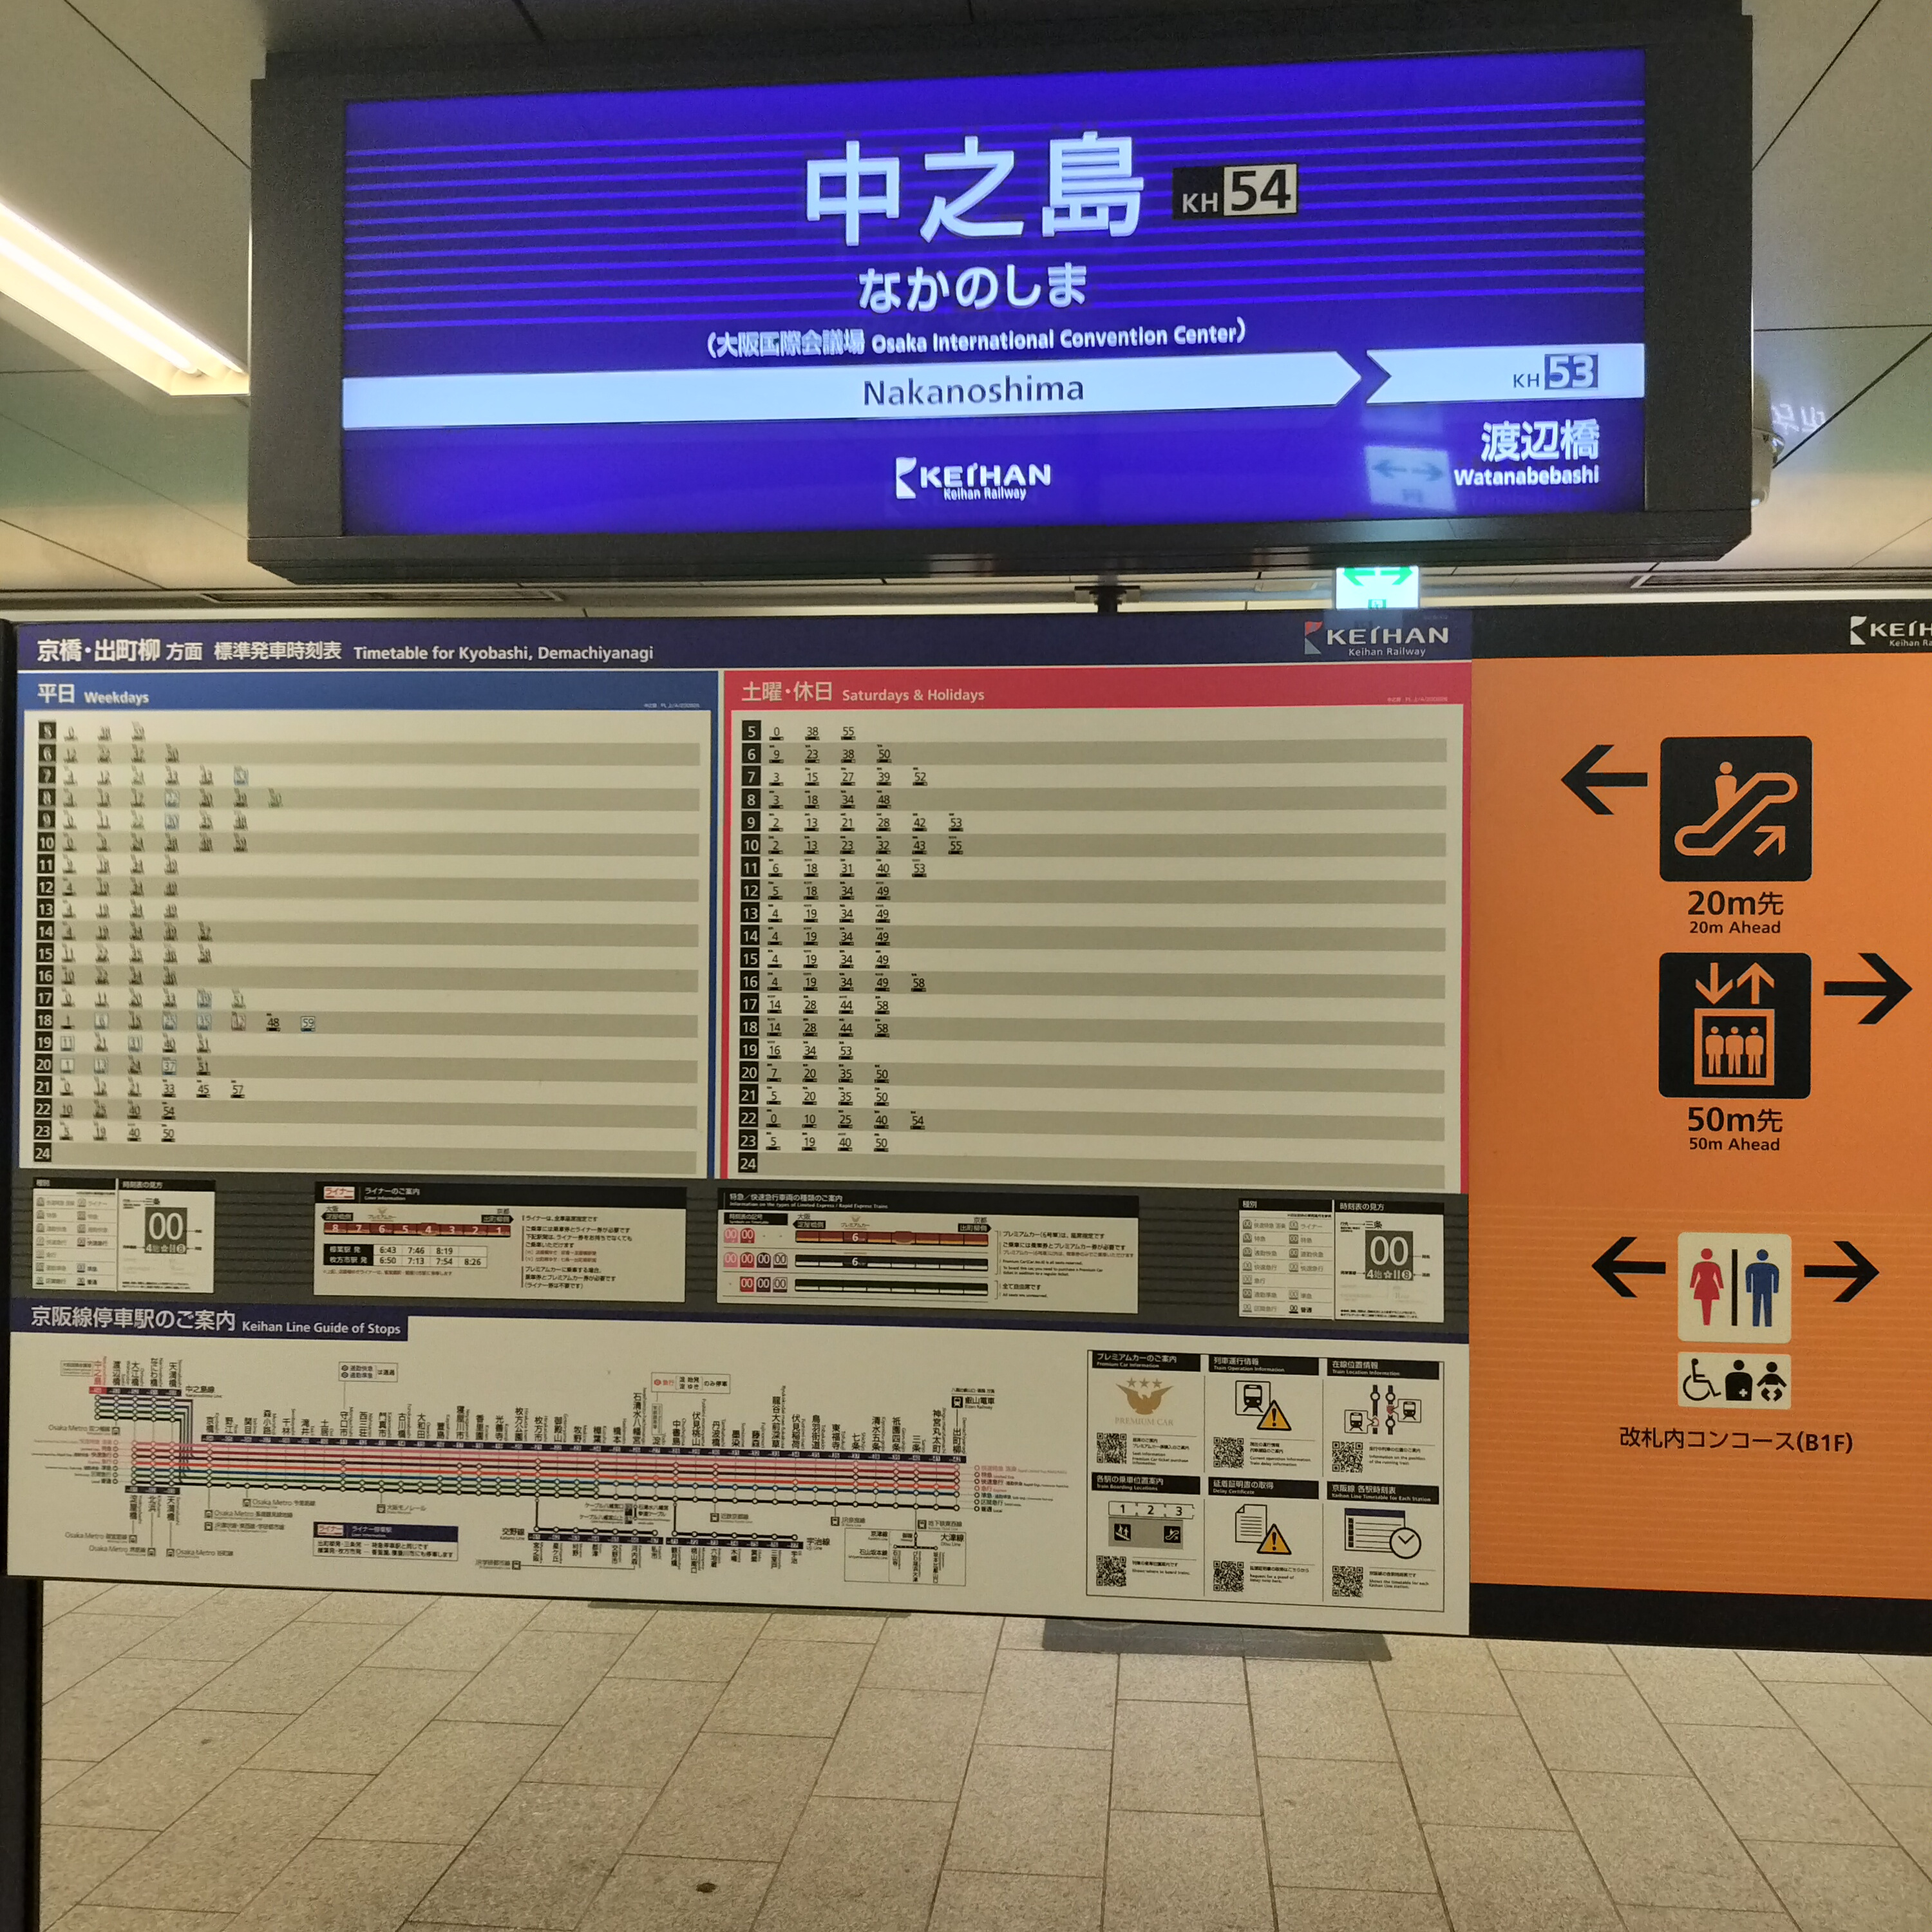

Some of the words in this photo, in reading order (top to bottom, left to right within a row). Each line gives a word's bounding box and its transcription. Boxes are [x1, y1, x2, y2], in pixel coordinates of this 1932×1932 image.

[806, 131, 1144, 247] 中之島
[1182, 193, 1218, 214] KH
[1230, 170, 1291, 212] 54
[858, 261, 1088, 314] なかのしま
[872, 334, 927, 354] Osaka
[933, 328, 1054, 352] International
[1060, 325, 1167, 348] Convention
[1174, 317, 1245, 345] Center)
[1513, 374, 1540, 388] KH
[1547, 355, 1596, 388] 53
[863, 375, 1085, 408] Nakanoshima
[1481, 419, 1600, 463] 渡辺橋
[920, 462, 1051, 488] KEIHAN
[1454, 466, 1600, 487] Watanabebashi
[943, 488, 980, 500] Keihan
[984, 486, 1027, 501] Railway
[1327, 626, 1448, 645] KEIHAN
[37, 638, 160, 663] 京橋・出町柳
[166, 642, 203, 661] 方面
[214, 641, 342, 661] 標準発車時刻表
[354, 646, 428, 660] Timetable
[432, 646, 454, 660] for
[459, 646, 533, 662] Kyobashi,
[538, 646, 654, 663] Demachiyanagi
[1349, 648, 1383, 656] Keihan
[1387, 647, 1426, 657] Railway
[37, 683, 75, 704] 平日
[84, 692, 149, 704] Weekdays
[742, 681, 833, 703] 土曜・休日
[842, 690, 909, 703] Saturdays
[913, 690, 923, 701] &
[928, 690, 985, 704] Holidays
[748, 726, 755, 737] 5
[773, 727, 780, 736] 0
[806, 727, 819, 736] 38
[842, 727, 855, 736] 55
[748, 748, 755, 760] 6
[748, 772, 755, 783] 7
[773, 772, 780, 782] 3
[808, 772, 819, 782] 15
[842, 772, 854, 782] 27
[878, 772, 890, 782] 39
[914, 772, 926, 782] 52
[748, 795, 755, 806] 8
[747, 817, 755, 829] 9
[773, 818, 779, 828] 2
[807, 818, 818, 828] 13
[842, 818, 853, 828] 21
[878, 818, 890, 828] 28
[914, 818, 926, 828] 42
[951, 818, 962, 828] 53
[39, 837, 54, 849] 10
[744, 840, 759, 851] 10
[773, 841, 779, 850] 2
[807, 841, 818, 850] 13
[842, 841, 853, 850] 23
[878, 841, 890, 850] 32
[913, 841, 925, 850] 43
[950, 841, 962, 850] 55
[744, 863, 757, 874] 11
[39, 882, 53, 893] 12
[744, 886, 759, 896] 12
[1688, 891, 1783, 915] 20m先
[743, 908, 758, 920] 13
[1690, 922, 1723, 933] 20m
[1729, 921, 1780, 933] Ahead
[744, 931, 759, 942] 14
[39, 947, 52, 960] 15
[743, 953, 758, 965] 15
[743, 976, 758, 987] 16
[772, 978, 779, 987] 4
[806, 978, 817, 987] 19
[840, 978, 853, 987] 34
[876, 978, 889, 988] 49
[913, 978, 925, 988] 58
[743, 999, 757, 1010] 17
[37, 1014, 52, 1026] 18
[267, 1018, 279, 1028] 48
[303, 1018, 314, 1027] 59
[743, 1021, 757, 1033] 18
[743, 1045, 757, 1056] 19
[742, 1067, 757, 1079] 20
[36, 1081, 51, 1094] 21
[164, 1084, 175, 1094] 33
[198, 1084, 209, 1094] 45
[232, 1085, 243, 1094] 57
[741, 1090, 755, 1101] 21
[35, 1103, 51, 1115] 22
[163, 1106, 175, 1115] 54
[741, 1113, 755, 1124] 22
[770, 1114, 777, 1124] 0
[804, 1114, 816, 1124] 10
[840, 1115, 852, 1126] 25
[875, 1115, 888, 1126] 40
[912, 1116, 924, 1126] 54
[1688, 1107, 1783, 1132] 50m先
[35, 1126, 51, 1137] 23
[163, 1128, 174, 1138] 50
[741, 1135, 756, 1147] 23
[1690, 1137, 1722, 1150] 50m
[1727, 1137, 1779, 1150] Ahead
[35, 1148, 50, 1160] 24
[741, 1159, 756, 1170] 24
[1340, 1202, 1384, 1211] 時刻表の見方
[1370, 1236, 1408, 1265] 00
[31, 1305, 236, 1331] 京阪線停車駅のご案内
[242, 1321, 283, 1332] Keihan
[287, 1322, 310, 1332] Line
[314, 1322, 348, 1333] Guide
[352, 1323, 365, 1333] of
[368, 1323, 401, 1336] Stops
[1097, 1354, 1177, 1363] プレミアムカーのご案内
[1214, 1357, 1259, 1365] 列車運行情報
[1332, 1361, 1378, 1369] 在線位置情報
[1115, 1417, 1155, 1425] PREMIUM
[1620, 1426, 1853, 1454] 改札内コンコース(B1F)
[1148, 1506, 1153, 1514] 2
[1176, 1507, 1182, 1515] 3
